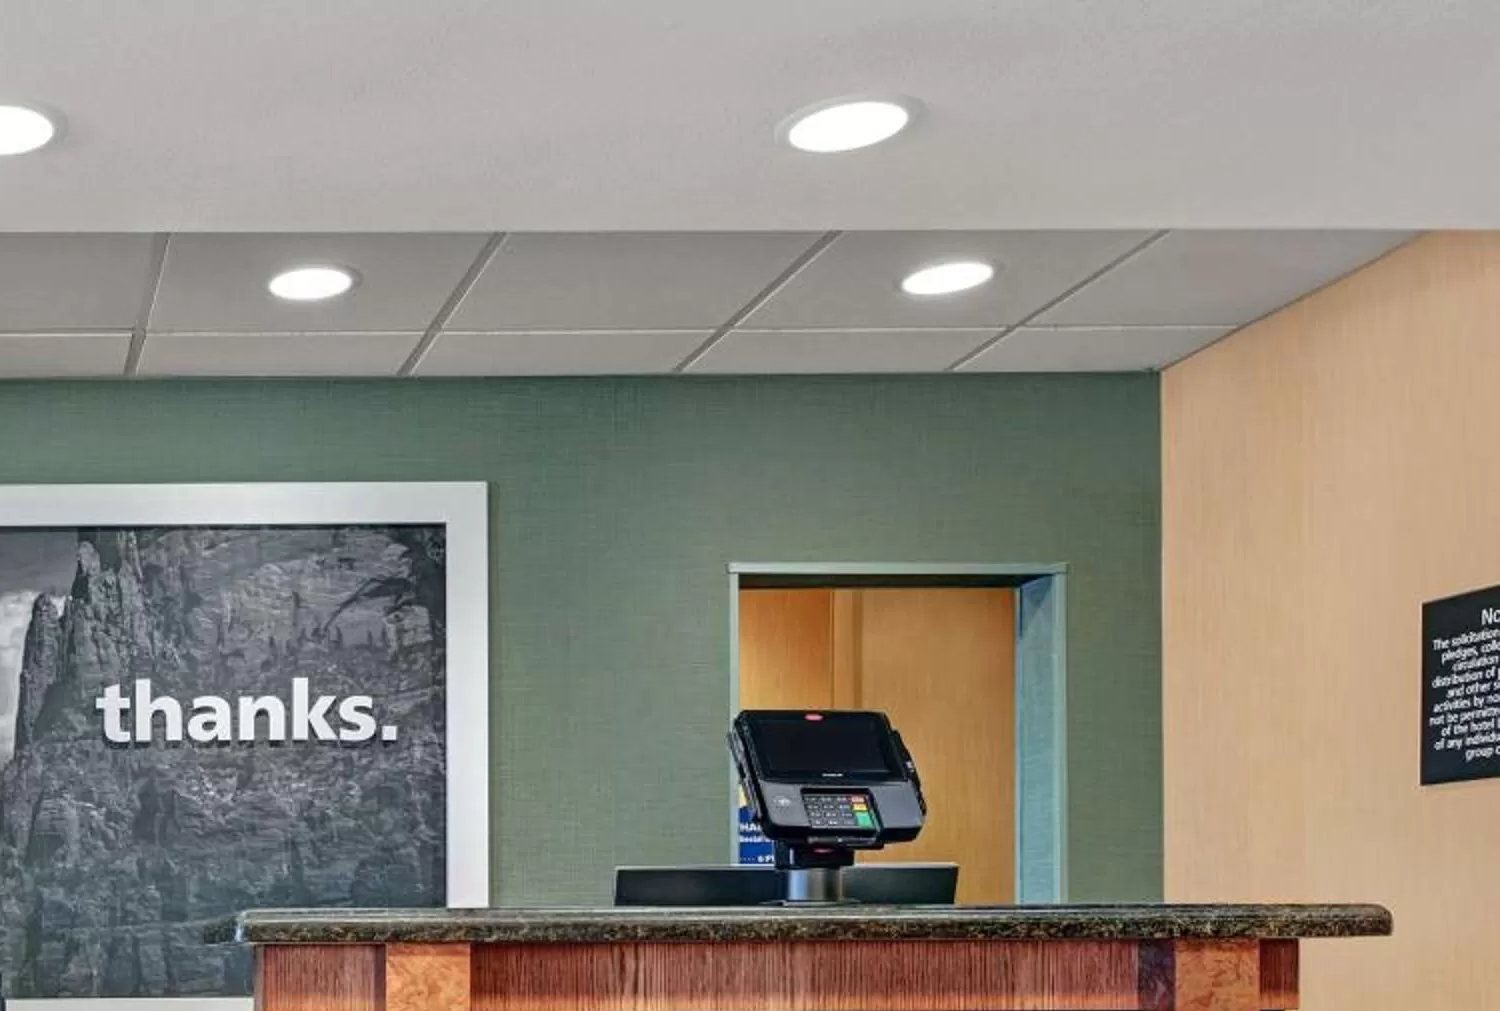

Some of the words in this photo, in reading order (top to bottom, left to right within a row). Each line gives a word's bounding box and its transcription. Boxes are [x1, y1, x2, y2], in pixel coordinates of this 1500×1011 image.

[1485, 666, 1496, 679] of
[1446, 684, 1465, 698] and
[1466, 682, 1491, 695] other
[1473, 695, 1484, 709] by
[96, 677, 398, 743] thanks.
[1429, 714, 1444, 726] not
[1446, 712, 1459, 723] be
[1441, 724, 1451, 737] of
[1453, 724, 1468, 735] the
[1470, 717, 1495, 732] hotel
[1433, 737, 1444, 750] of
[1446, 738, 1462, 750] any
[1465, 747, 1493, 762] group
